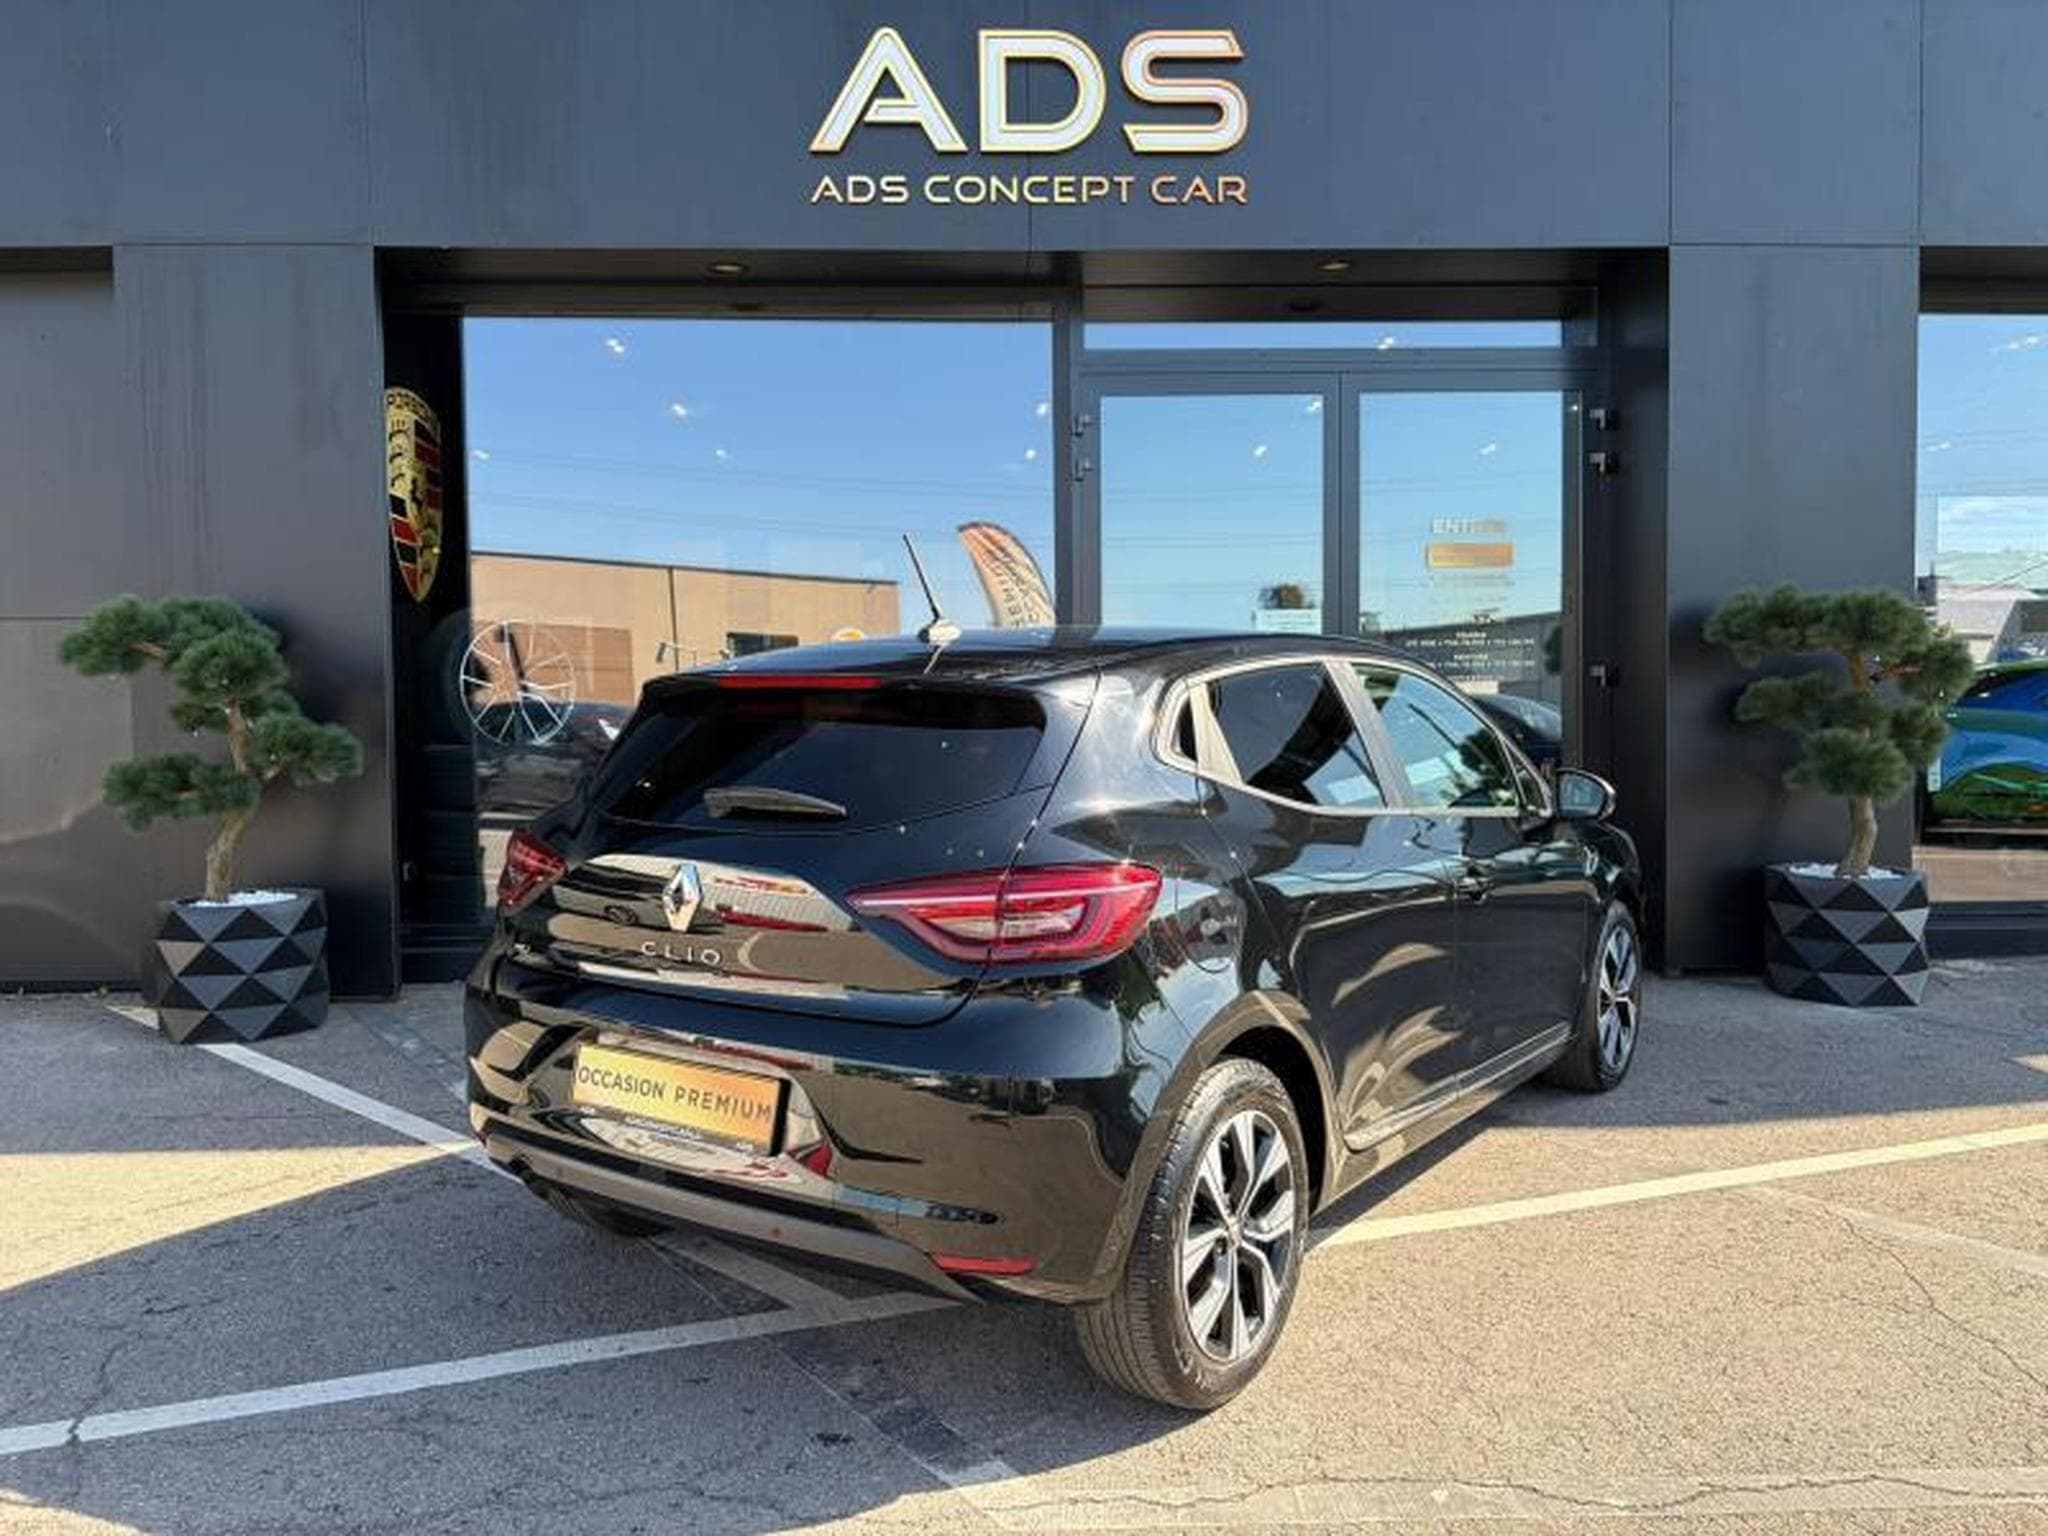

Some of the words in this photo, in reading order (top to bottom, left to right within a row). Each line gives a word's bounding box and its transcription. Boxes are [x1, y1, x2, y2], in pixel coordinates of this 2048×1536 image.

[809, 27, 1248, 153] ADS
[811, 176, 909, 204] ADS
[923, 176, 1135, 204] CONCEPT
[1150, 176, 1248, 204] CAR
[641, 941, 721, 966] CLIO
[577, 1065, 667, 1100] OCCASION
[674, 1087, 773, 1124] PREMIUM
